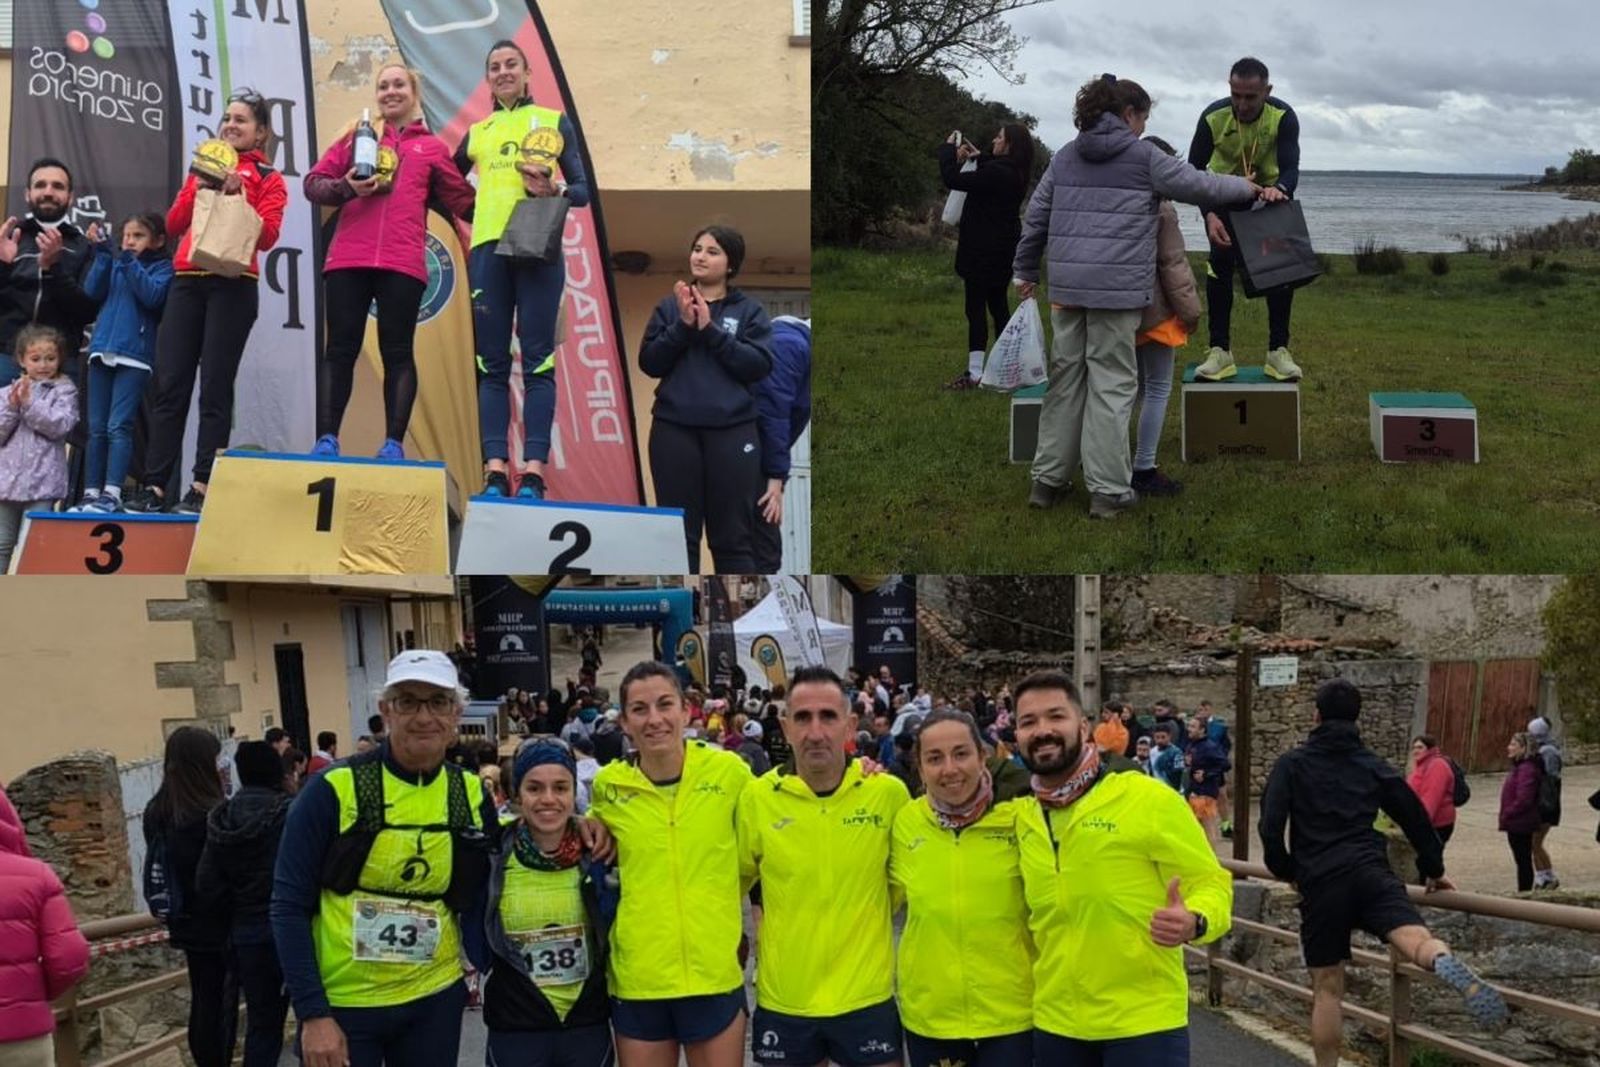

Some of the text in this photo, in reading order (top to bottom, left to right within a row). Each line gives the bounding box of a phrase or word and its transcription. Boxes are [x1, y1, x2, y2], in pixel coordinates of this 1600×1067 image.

[1234, 400, 1247, 424] 1
[1419, 419, 1436, 441] 3
[306, 476, 336, 532] 1
[84, 522, 126, 575] 3
[548, 520, 592, 575] 2
[378, 923, 418, 947] 43
[524, 947, 576, 973] 138
